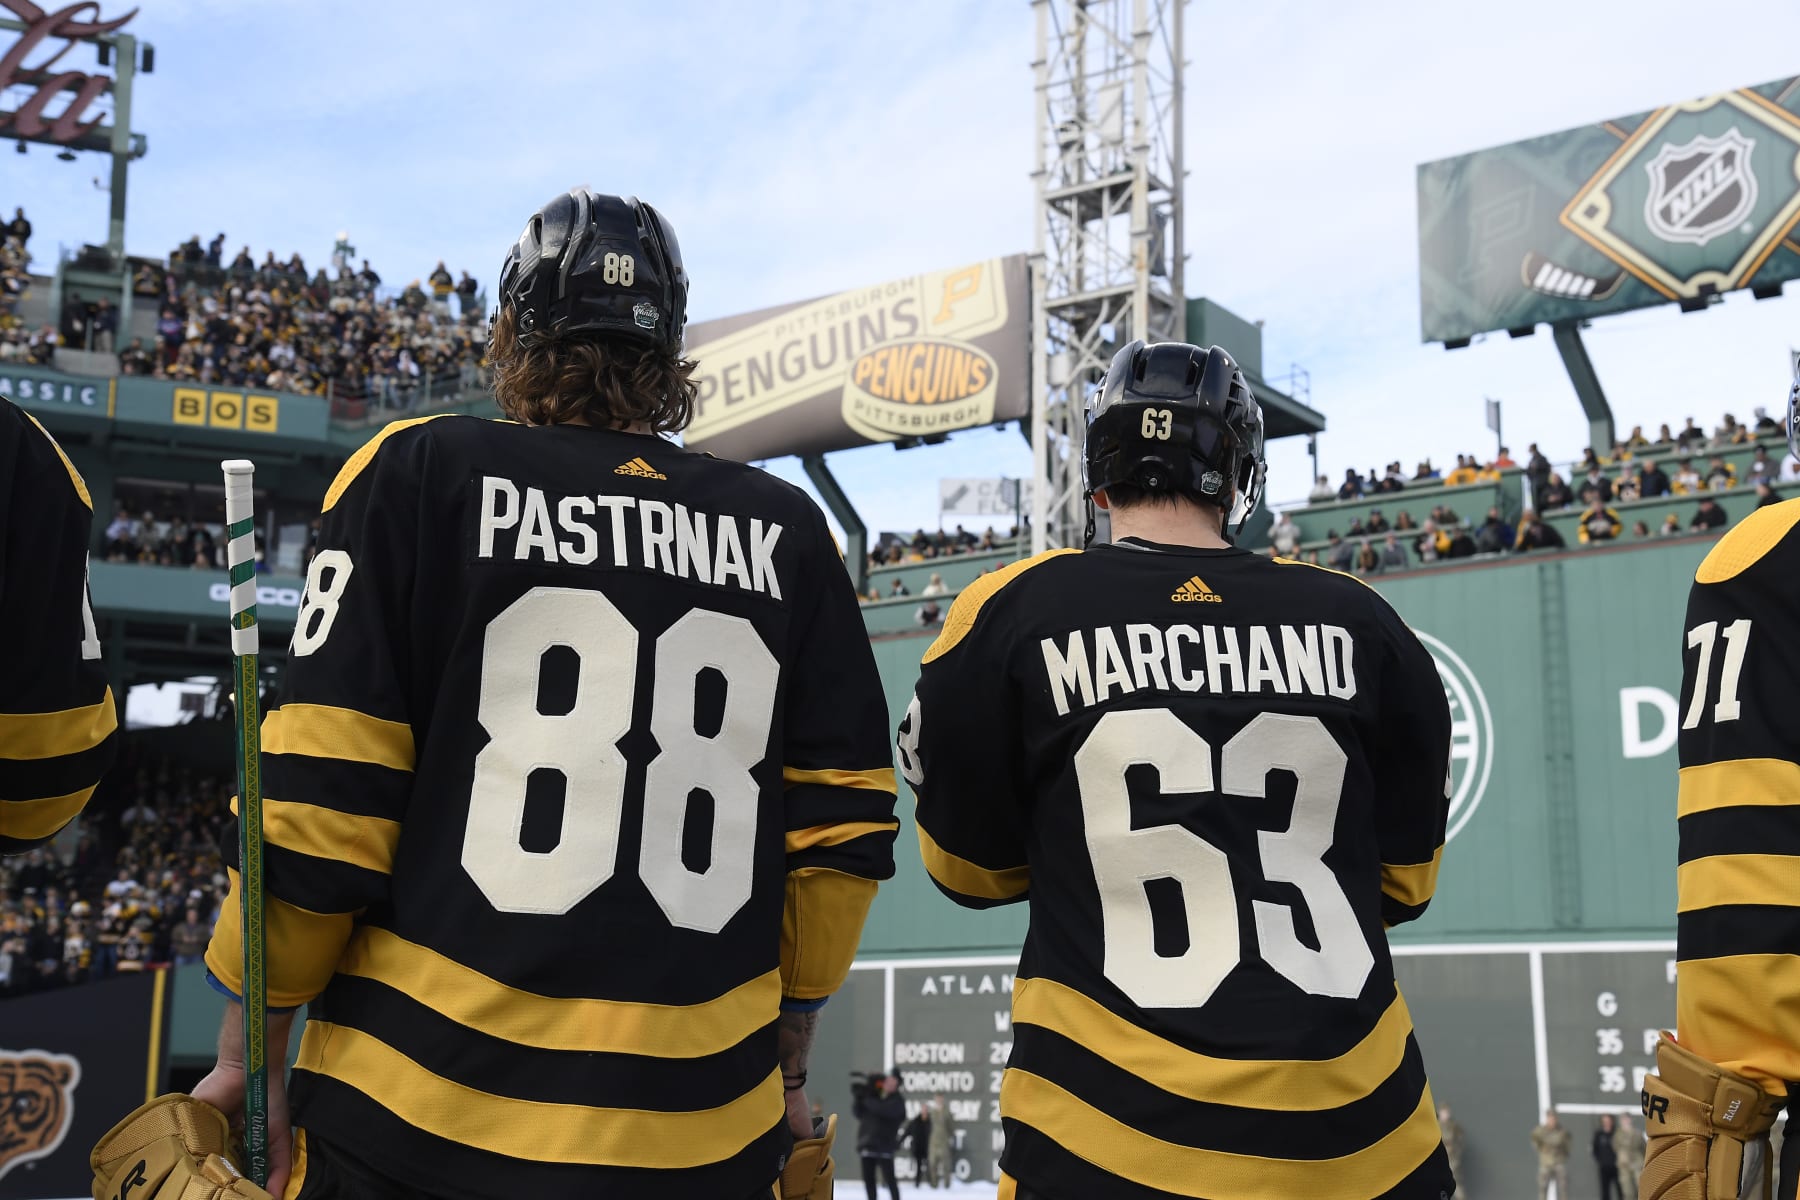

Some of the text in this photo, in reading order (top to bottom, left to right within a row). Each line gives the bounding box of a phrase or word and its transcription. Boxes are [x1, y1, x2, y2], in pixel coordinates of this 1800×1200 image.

[1670, 157, 1734, 225] NHL
[603, 252, 635, 287] 88
[774, 276, 916, 341] PITTSBURGH
[932, 263, 985, 326] P
[698, 297, 919, 418] PENGUINS
[853, 341, 989, 405] PENGUINS
[178, 396, 272, 425] BOS
[853, 398, 982, 428] PITTSBURGH
[1141, 407, 1173, 440] 63
[613, 467, 668, 481] adidas
[478, 475, 784, 601] PASTRNAK
[289, 549, 355, 657] 8
[1171, 591, 1223, 603] adidas
[1040, 623, 1357, 716] MARCHAND
[1682, 619, 1753, 730] 71
[461, 586, 781, 934] 88
[1074, 707, 1376, 1009] 63
[994, 1010, 1011, 1033] W
[1597, 992, 1618, 1017] G
[895, 1042, 965, 1065] BOSTON
[1596, 1028, 1624, 1055] 35
[1599, 1066, 1627, 1093] 35
[1722, 1099, 1741, 1122] HALL
